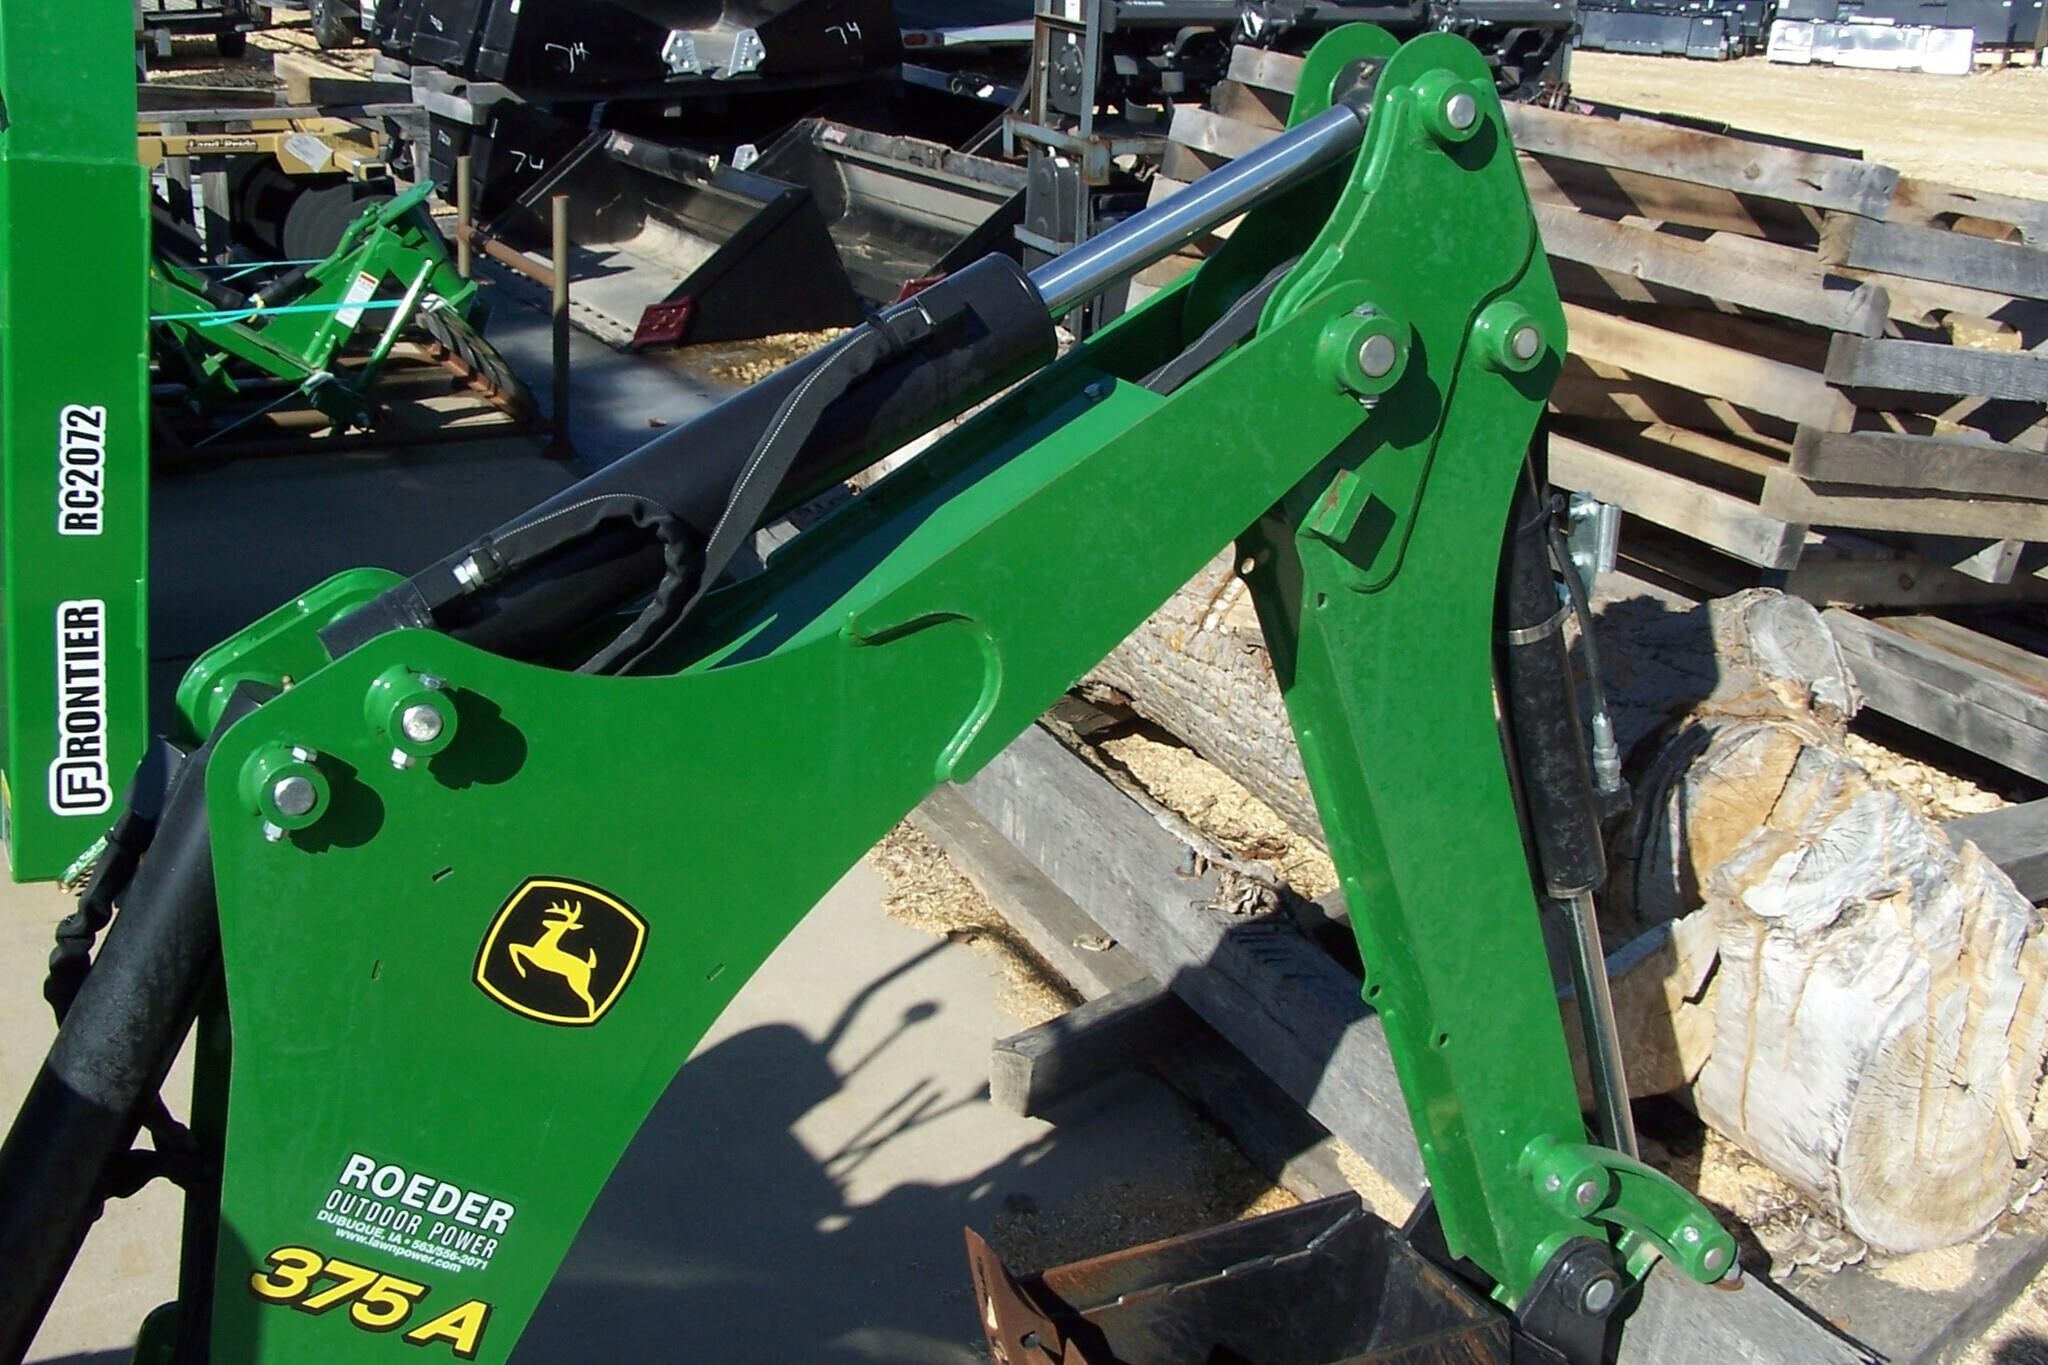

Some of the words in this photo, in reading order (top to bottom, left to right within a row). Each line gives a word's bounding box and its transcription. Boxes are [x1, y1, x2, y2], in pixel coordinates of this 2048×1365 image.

[824, 21, 862, 45] 74
[64, 408, 102, 532] RC2072
[56, 604, 107, 809] FRONTIER
[325, 1189, 424, 1236] OUTDOOR
[428, 1221, 498, 1259] POWER
[339, 1152, 515, 1235] ROEDER
[335, 1227, 462, 1273] www.lawnpower.com
[387, 1233, 402, 1245] IA
[411, 1238, 489, 1271] 563/556-2071
[250, 1247, 430, 1332] 375
[402, 1298, 494, 1361] A
